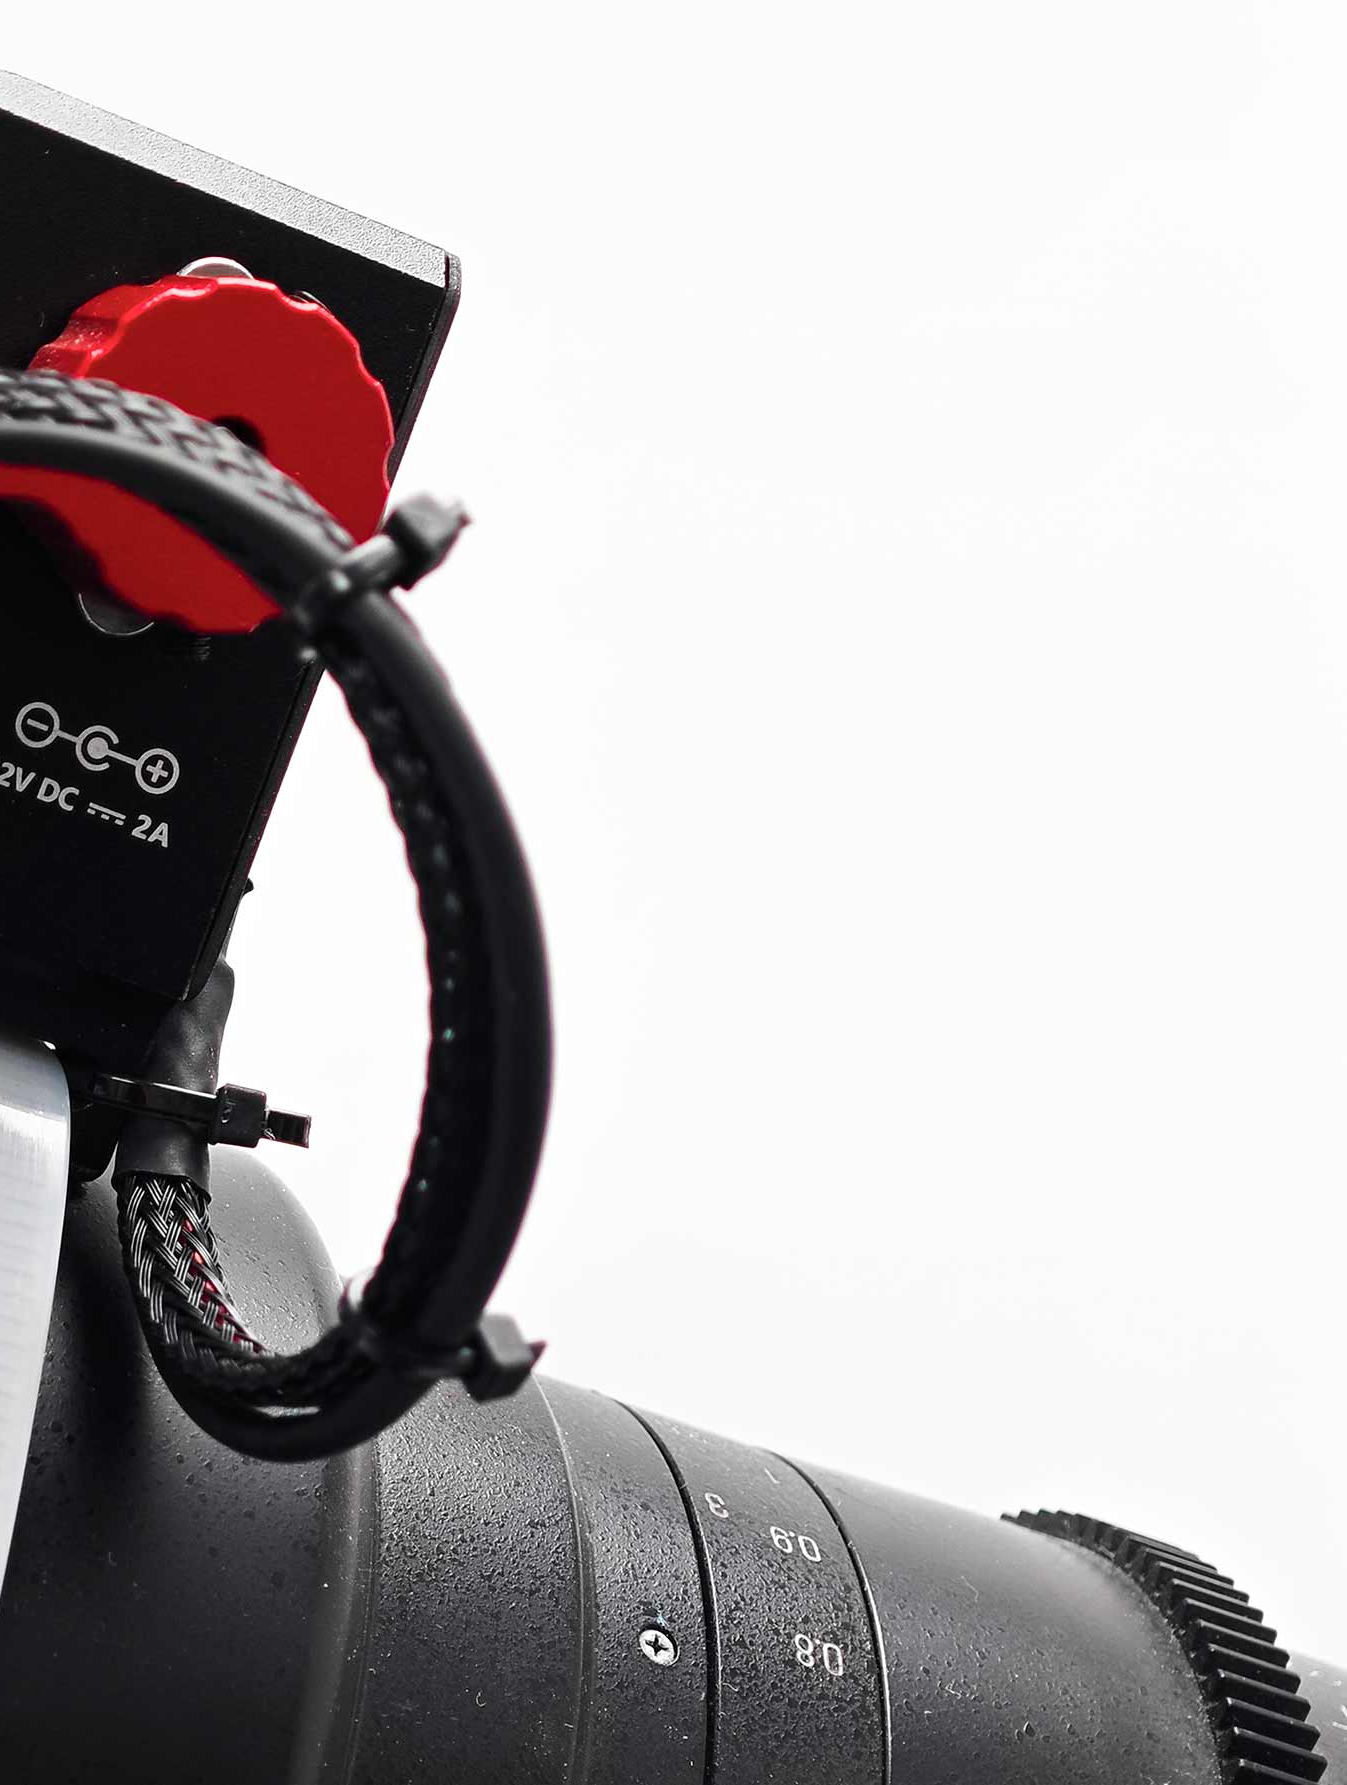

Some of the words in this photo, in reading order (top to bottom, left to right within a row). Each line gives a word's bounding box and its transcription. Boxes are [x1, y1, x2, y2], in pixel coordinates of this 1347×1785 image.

[37, 776, 80, 812] DC
[131, 814, 170, 848] 2A
[704, 1492, 730, 1518] 3
[769, 1525, 822, 1562] 0.9
[794, 1633, 844, 1677] 0.8
